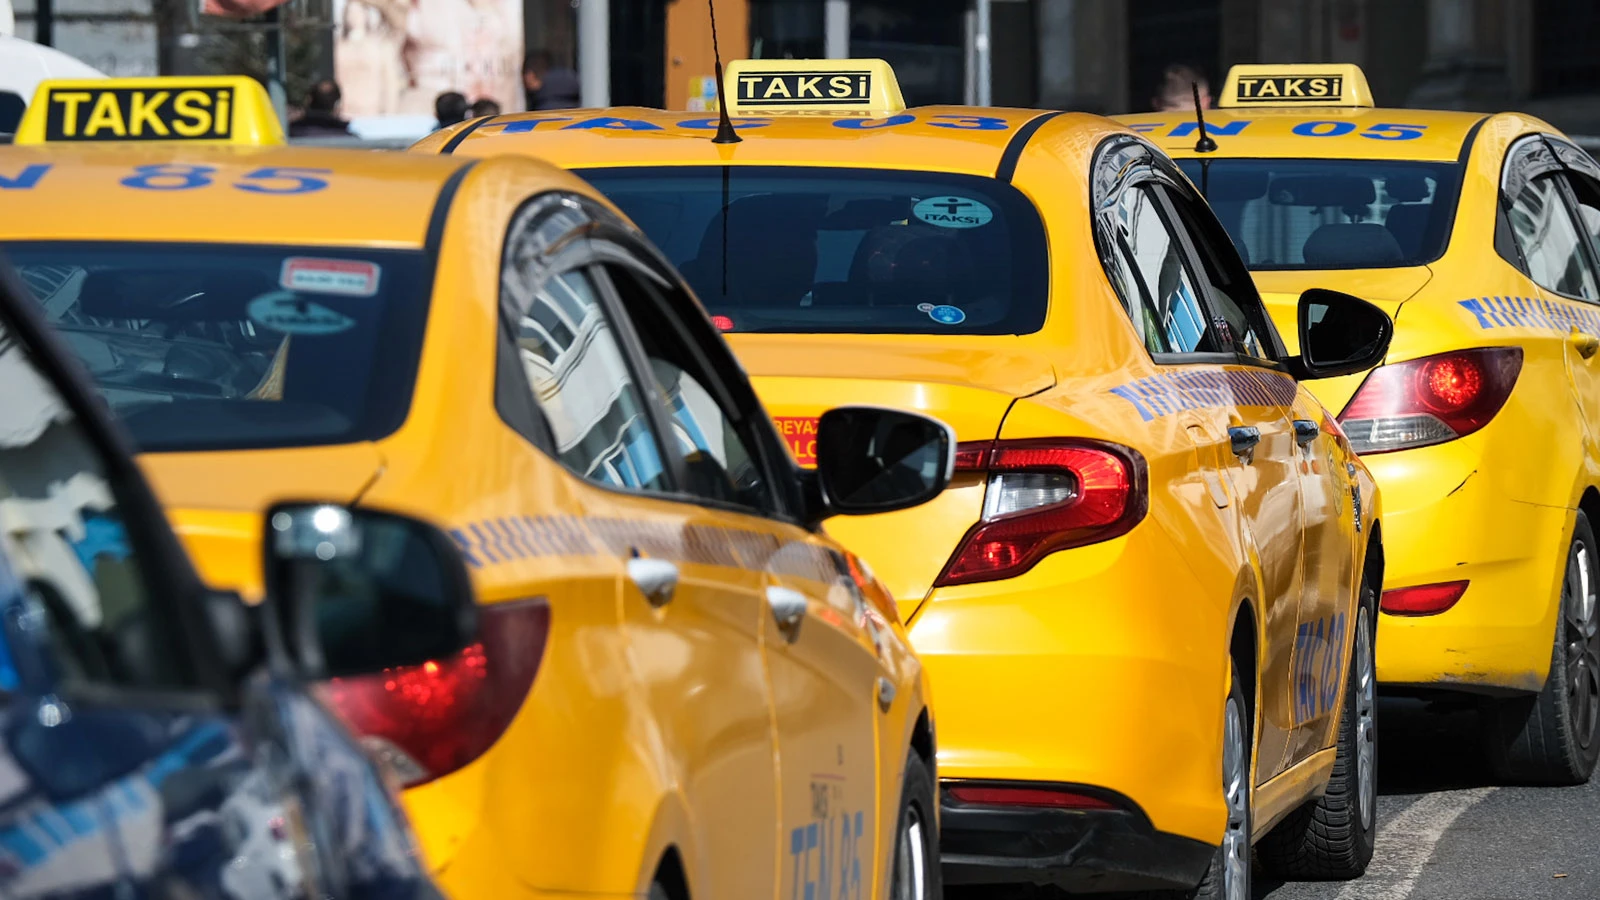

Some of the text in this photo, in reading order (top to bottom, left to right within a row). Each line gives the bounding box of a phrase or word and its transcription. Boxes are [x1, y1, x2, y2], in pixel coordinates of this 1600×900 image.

[482, 114, 1010, 134] TAC 03
[1291, 121, 1428, 142] 05
[119, 164, 333, 194] 85
[1294, 611, 1345, 725] TAC 03
